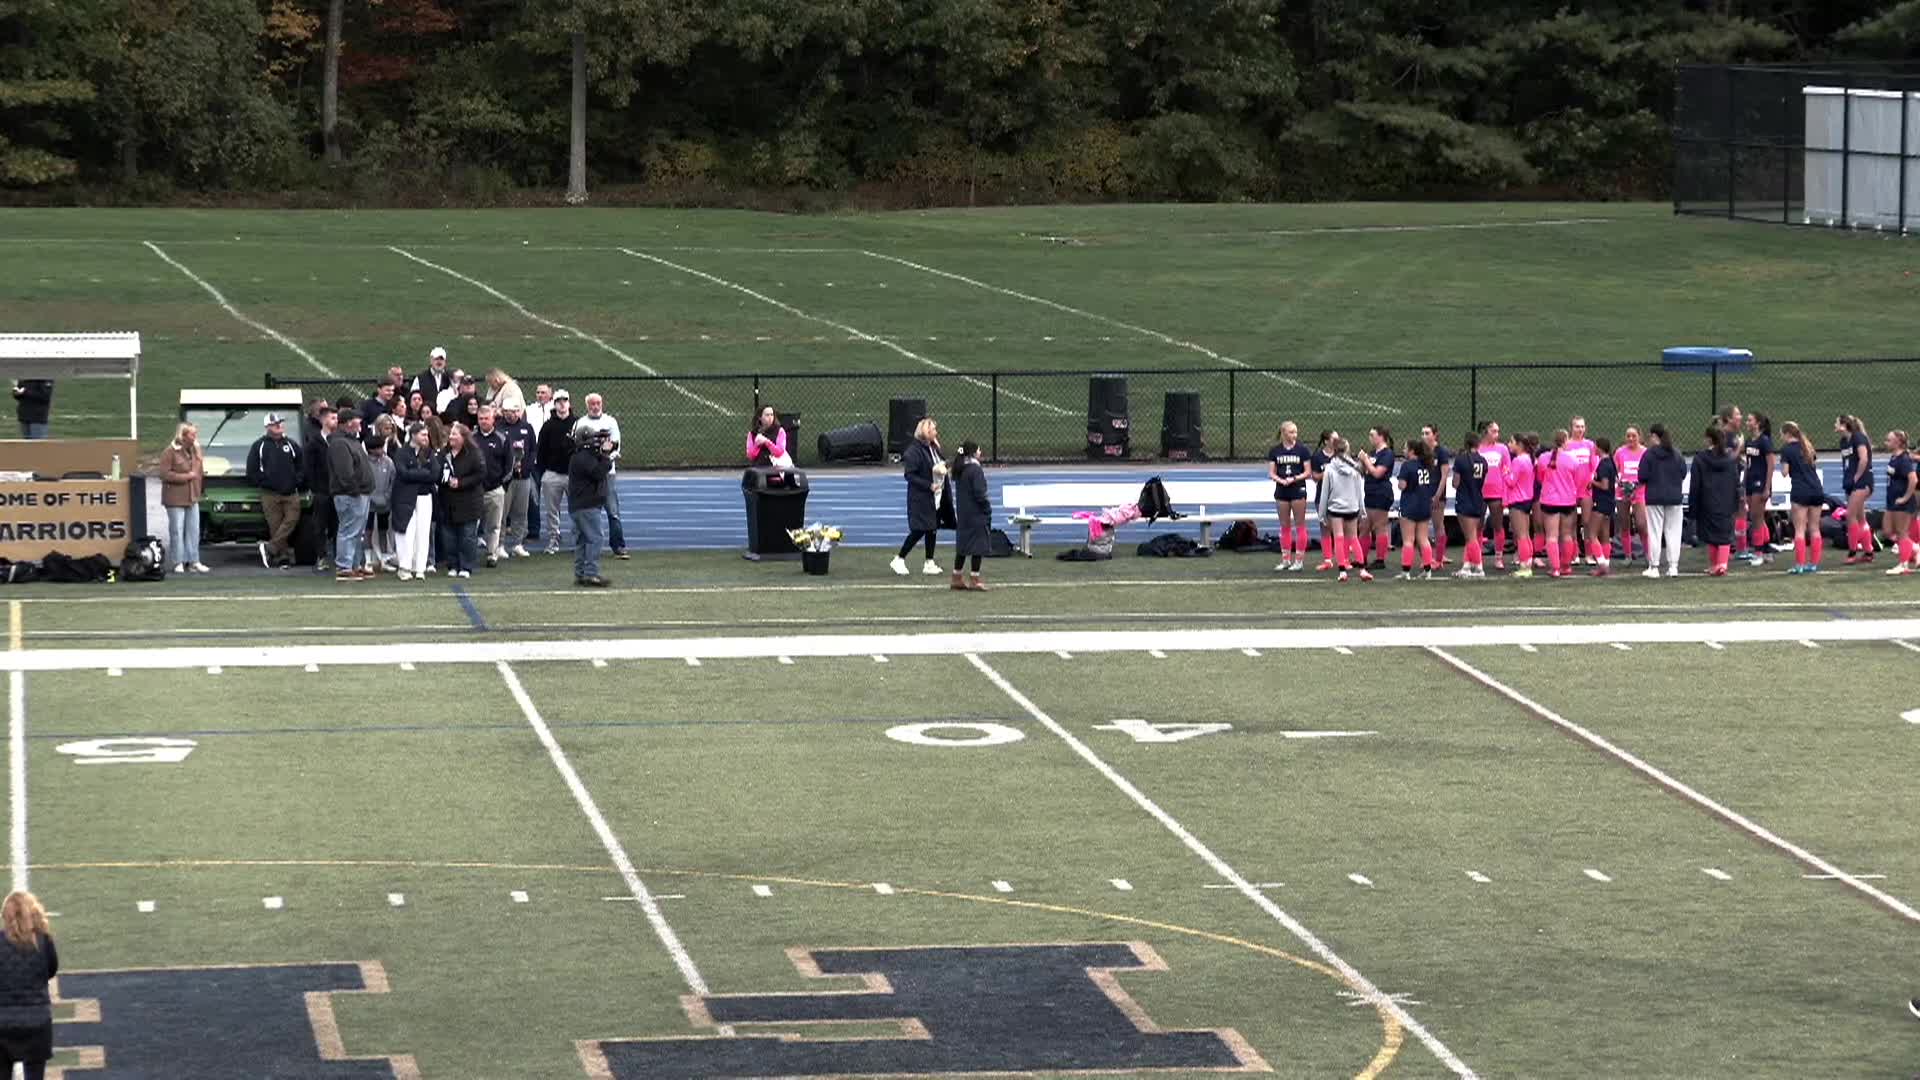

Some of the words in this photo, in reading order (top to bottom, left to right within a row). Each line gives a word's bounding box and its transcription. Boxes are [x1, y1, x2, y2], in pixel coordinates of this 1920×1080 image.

[1417, 469, 1430, 485] 22
[1473, 463, 1484, 479] 21
[43, 492, 70, 506] OF
[76, 492, 117, 505] THE
[0, 521, 126, 540] ARRIORS
